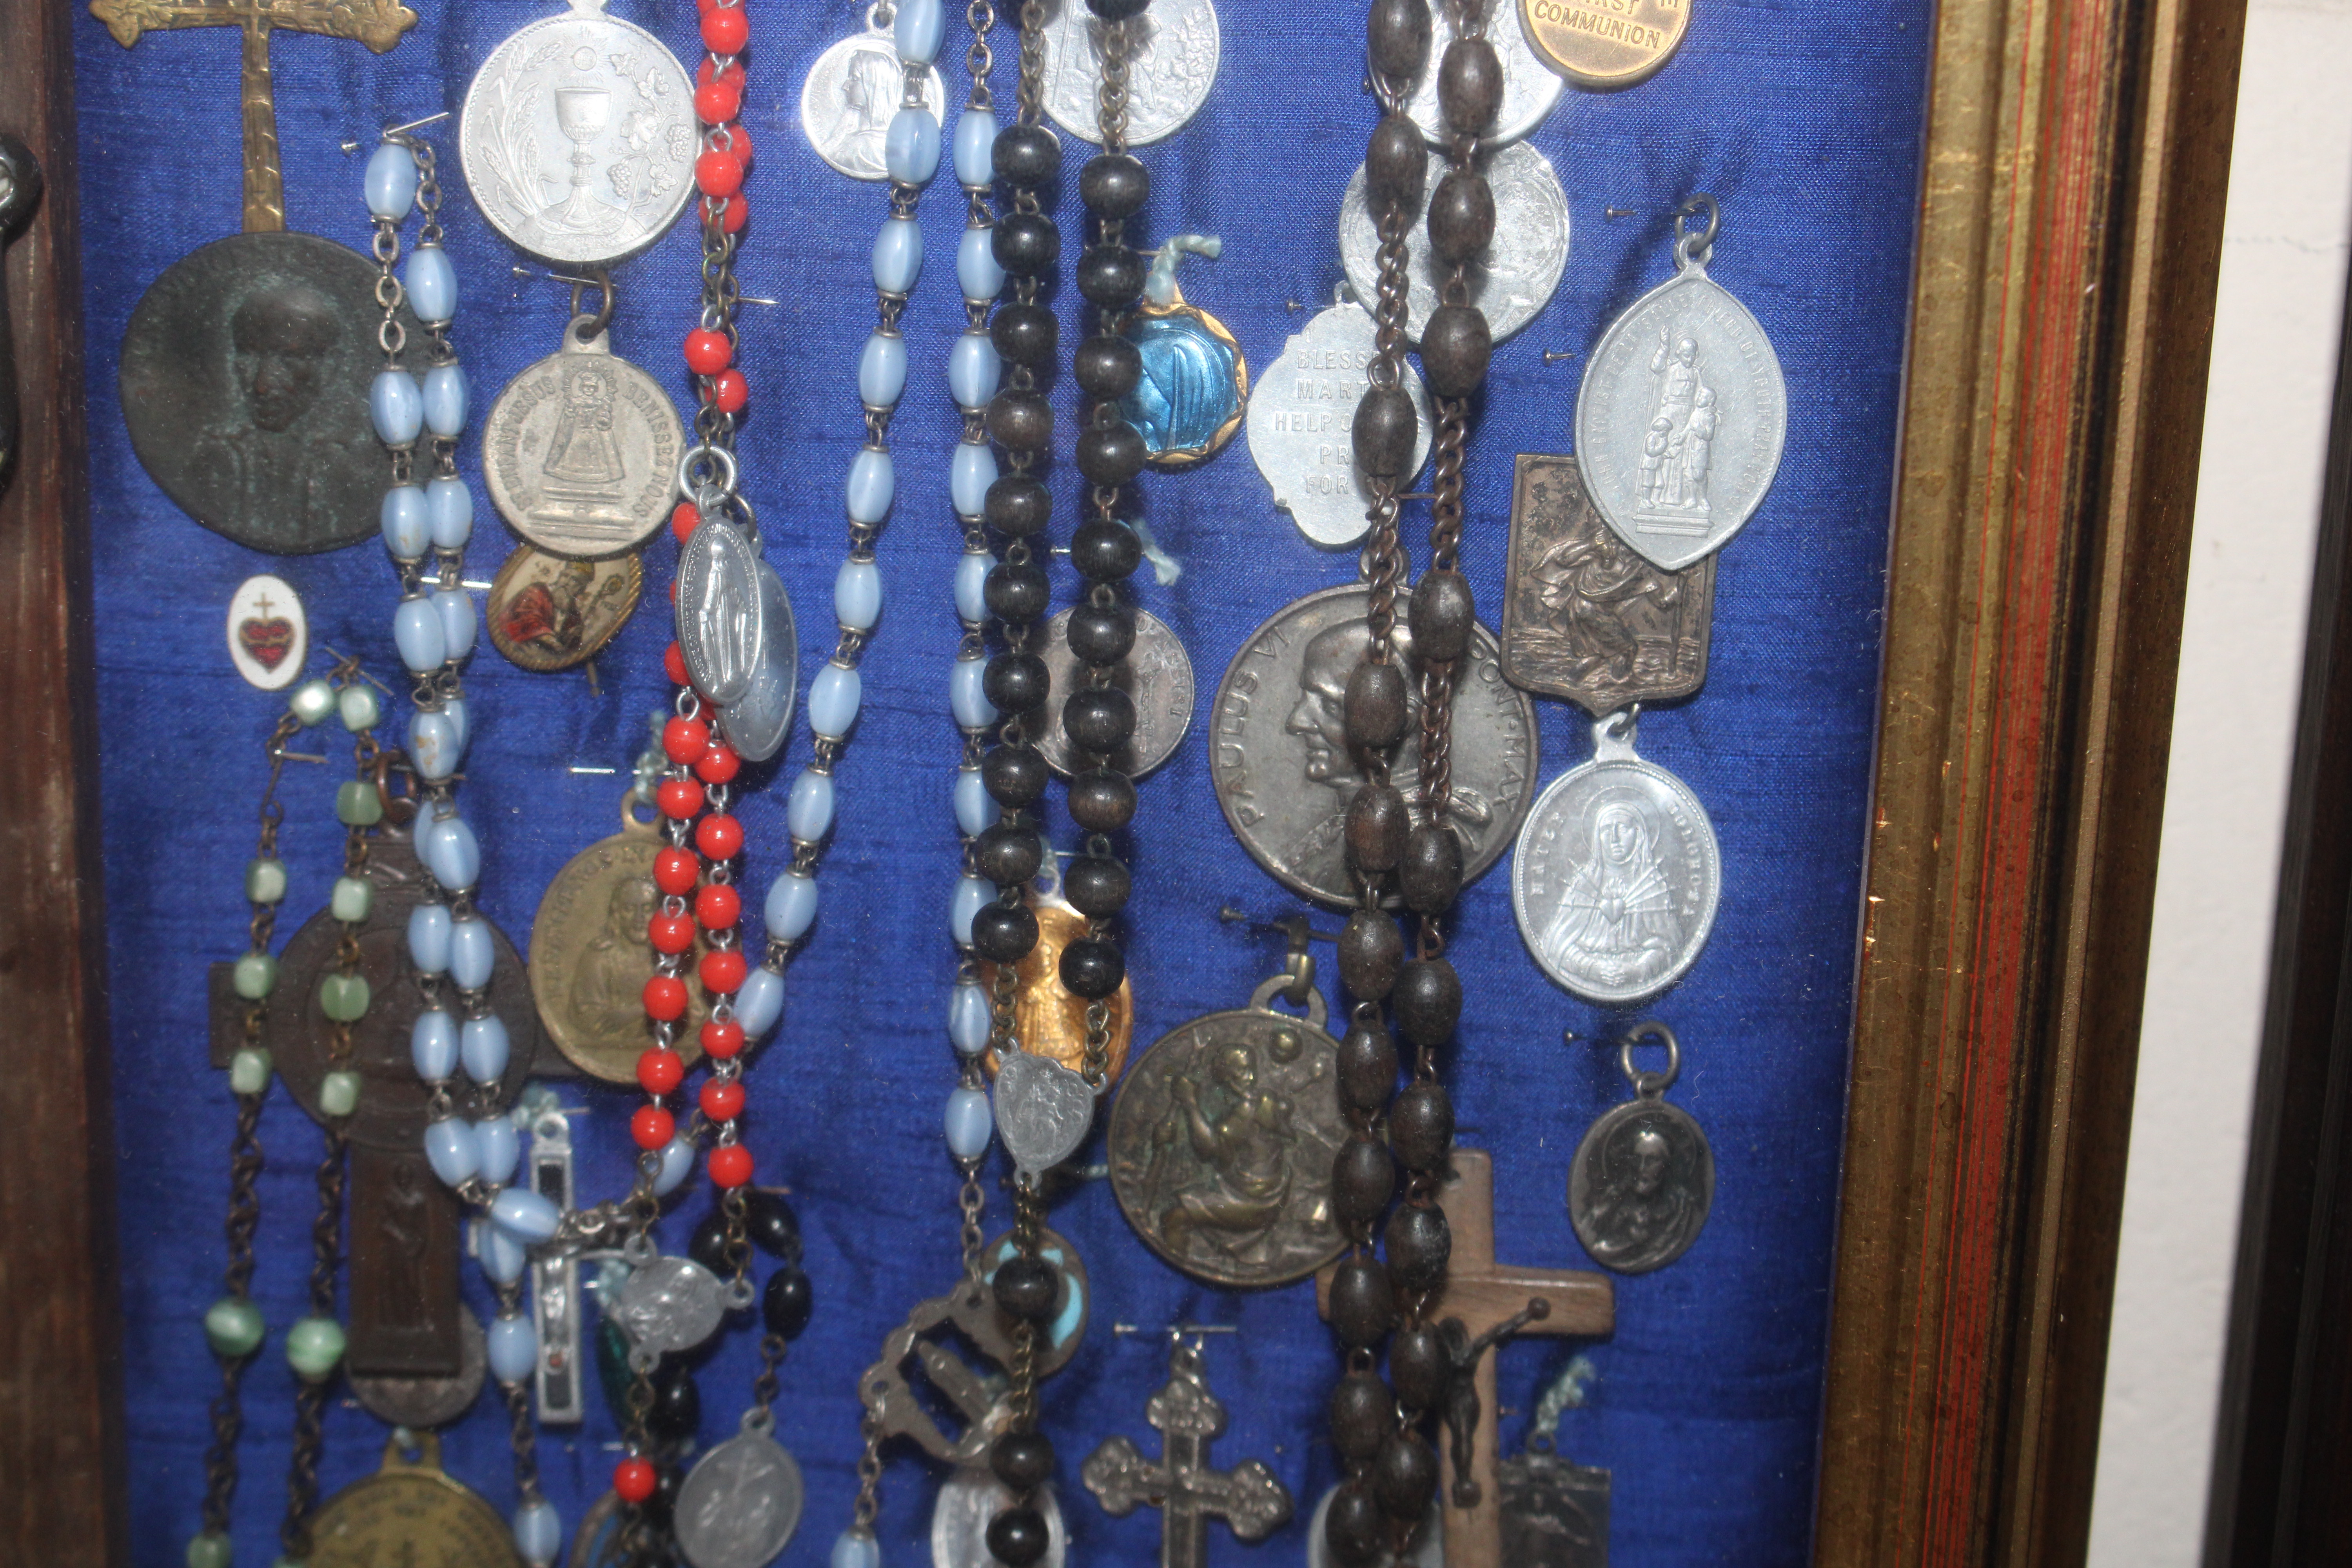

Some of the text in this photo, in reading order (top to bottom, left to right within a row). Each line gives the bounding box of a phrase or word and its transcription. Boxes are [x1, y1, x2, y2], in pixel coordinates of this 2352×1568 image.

[1534, 0, 1660, 49] COMMUNION
[1296, 349, 1381, 370] BLESS
[1274, 412, 1332, 433] HELP
[1305, 473, 1349, 495] FOR
[1218, 625, 1291, 829] PAULUS VI
